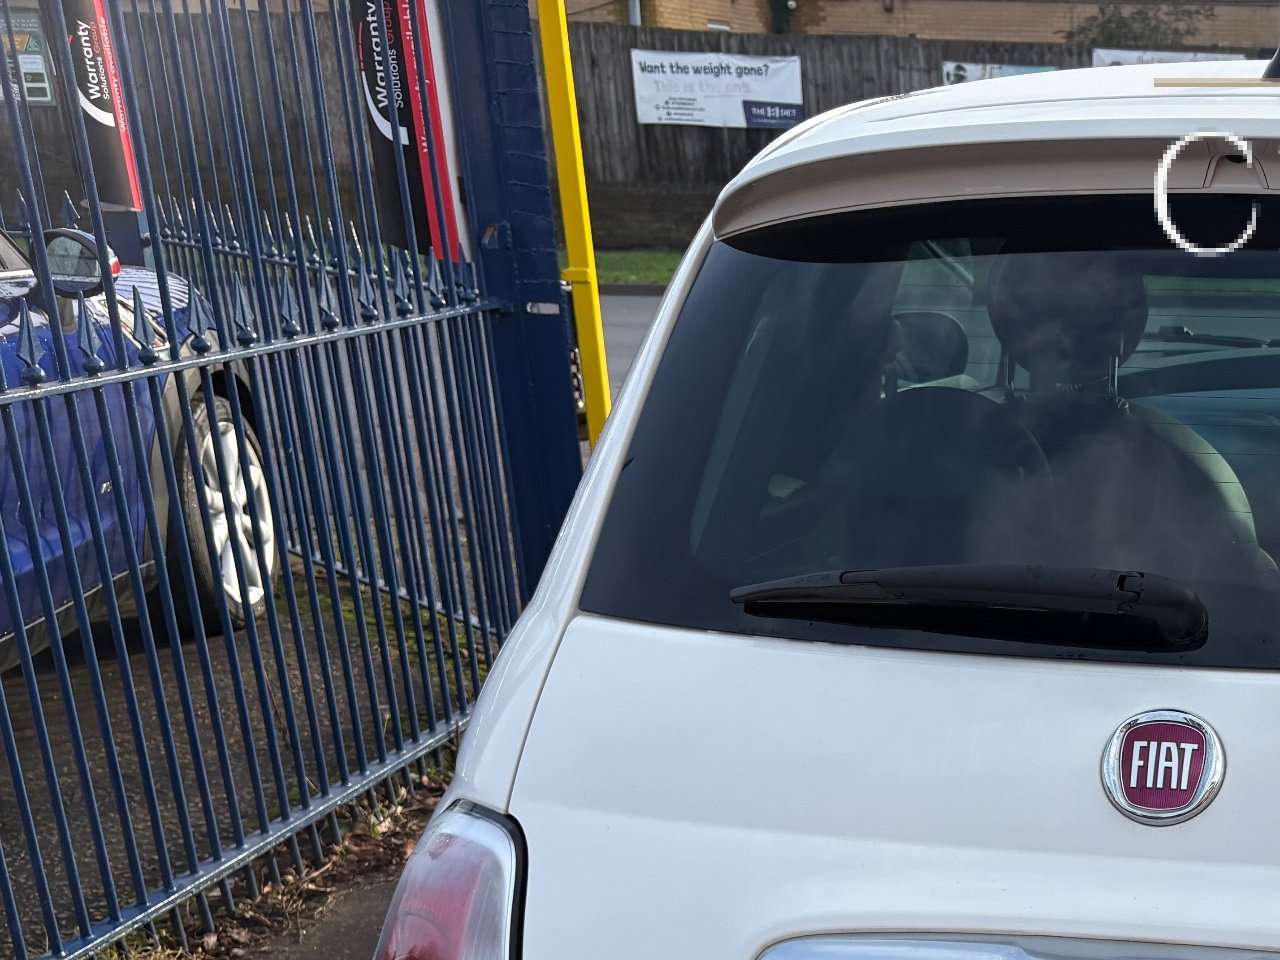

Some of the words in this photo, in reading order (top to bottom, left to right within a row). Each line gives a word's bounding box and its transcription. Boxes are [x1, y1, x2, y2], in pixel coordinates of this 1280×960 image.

[77, 20, 101, 100] Warranty
[97, 56, 110, 100] Solutions
[638, 61, 665, 74] Want
[669, 62, 689, 75] the
[692, 62, 732, 78] weight
[736, 64, 770, 78] gone?
[1129, 740, 1199, 790] FIAT
